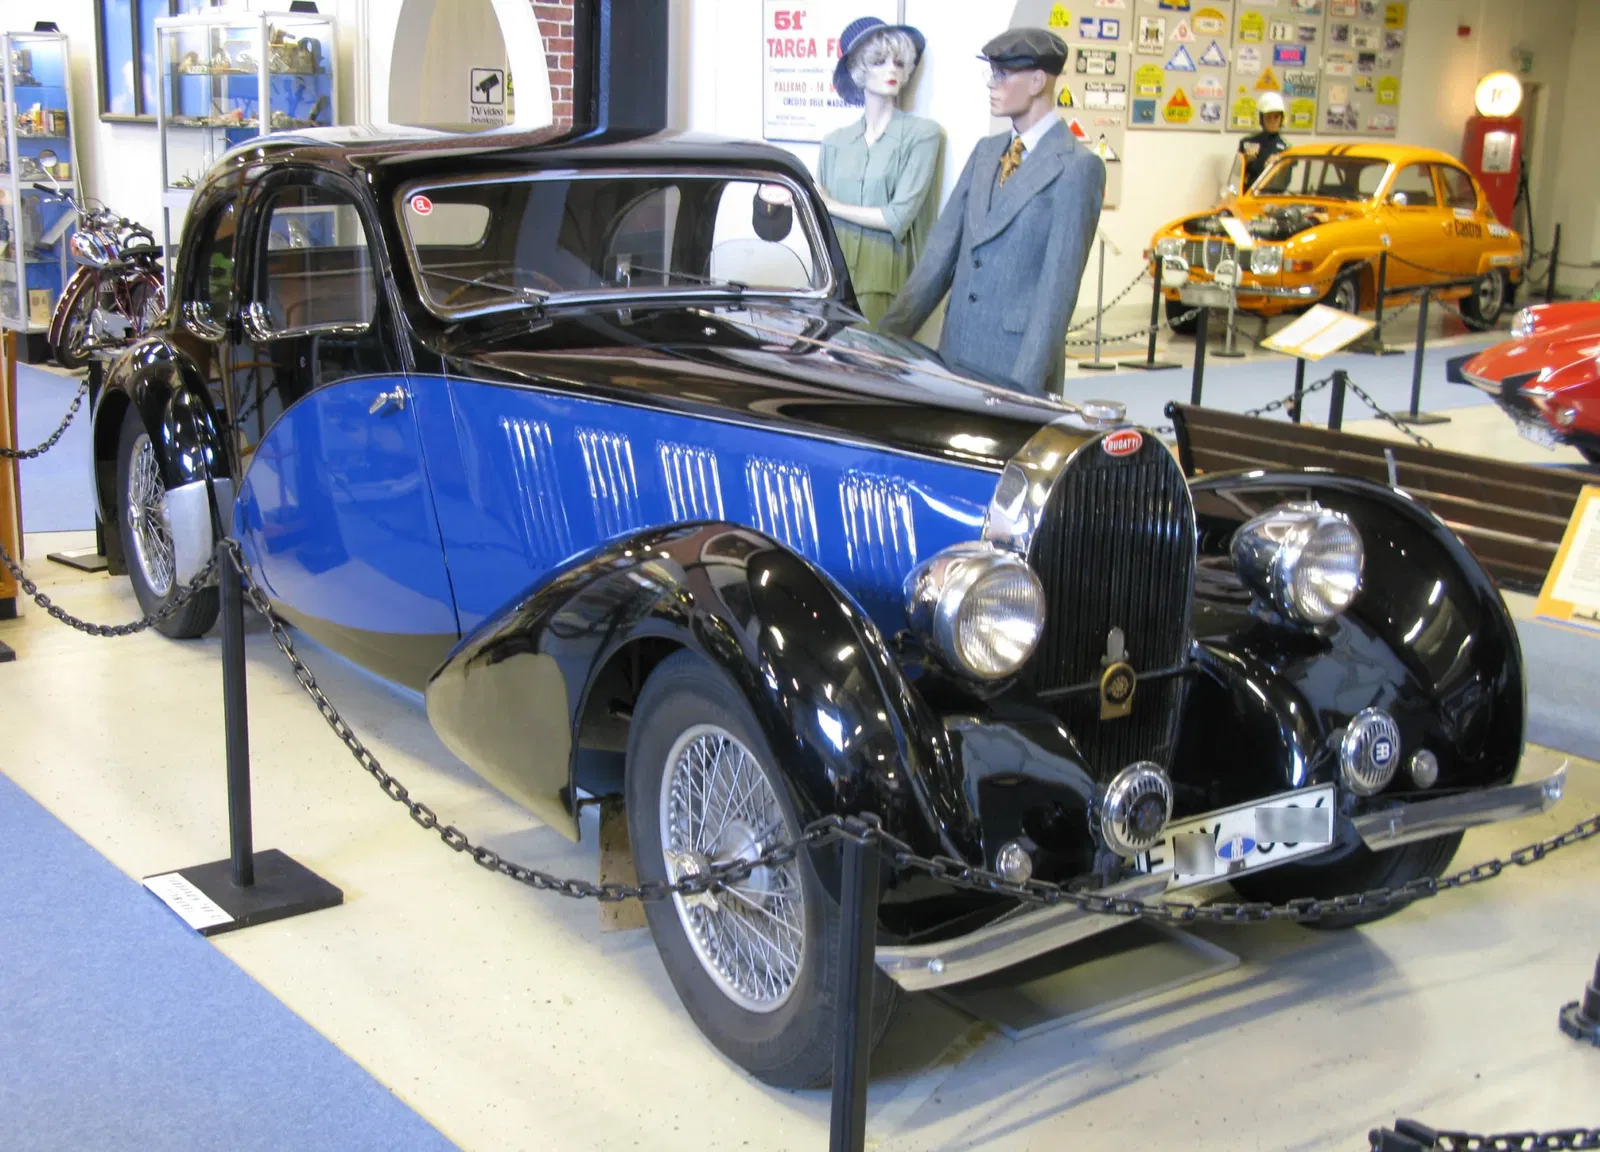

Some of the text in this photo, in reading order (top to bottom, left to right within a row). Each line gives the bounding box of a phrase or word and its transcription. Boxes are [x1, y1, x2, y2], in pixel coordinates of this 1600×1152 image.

[767, 37, 817, 58] TARGA
[774, 81, 807, 93] PALERMO
[470, 106, 504, 116] TV video
[1454, 219, 1482, 238] Castrol
[1107, 437, 1140, 451] BUGATTI
